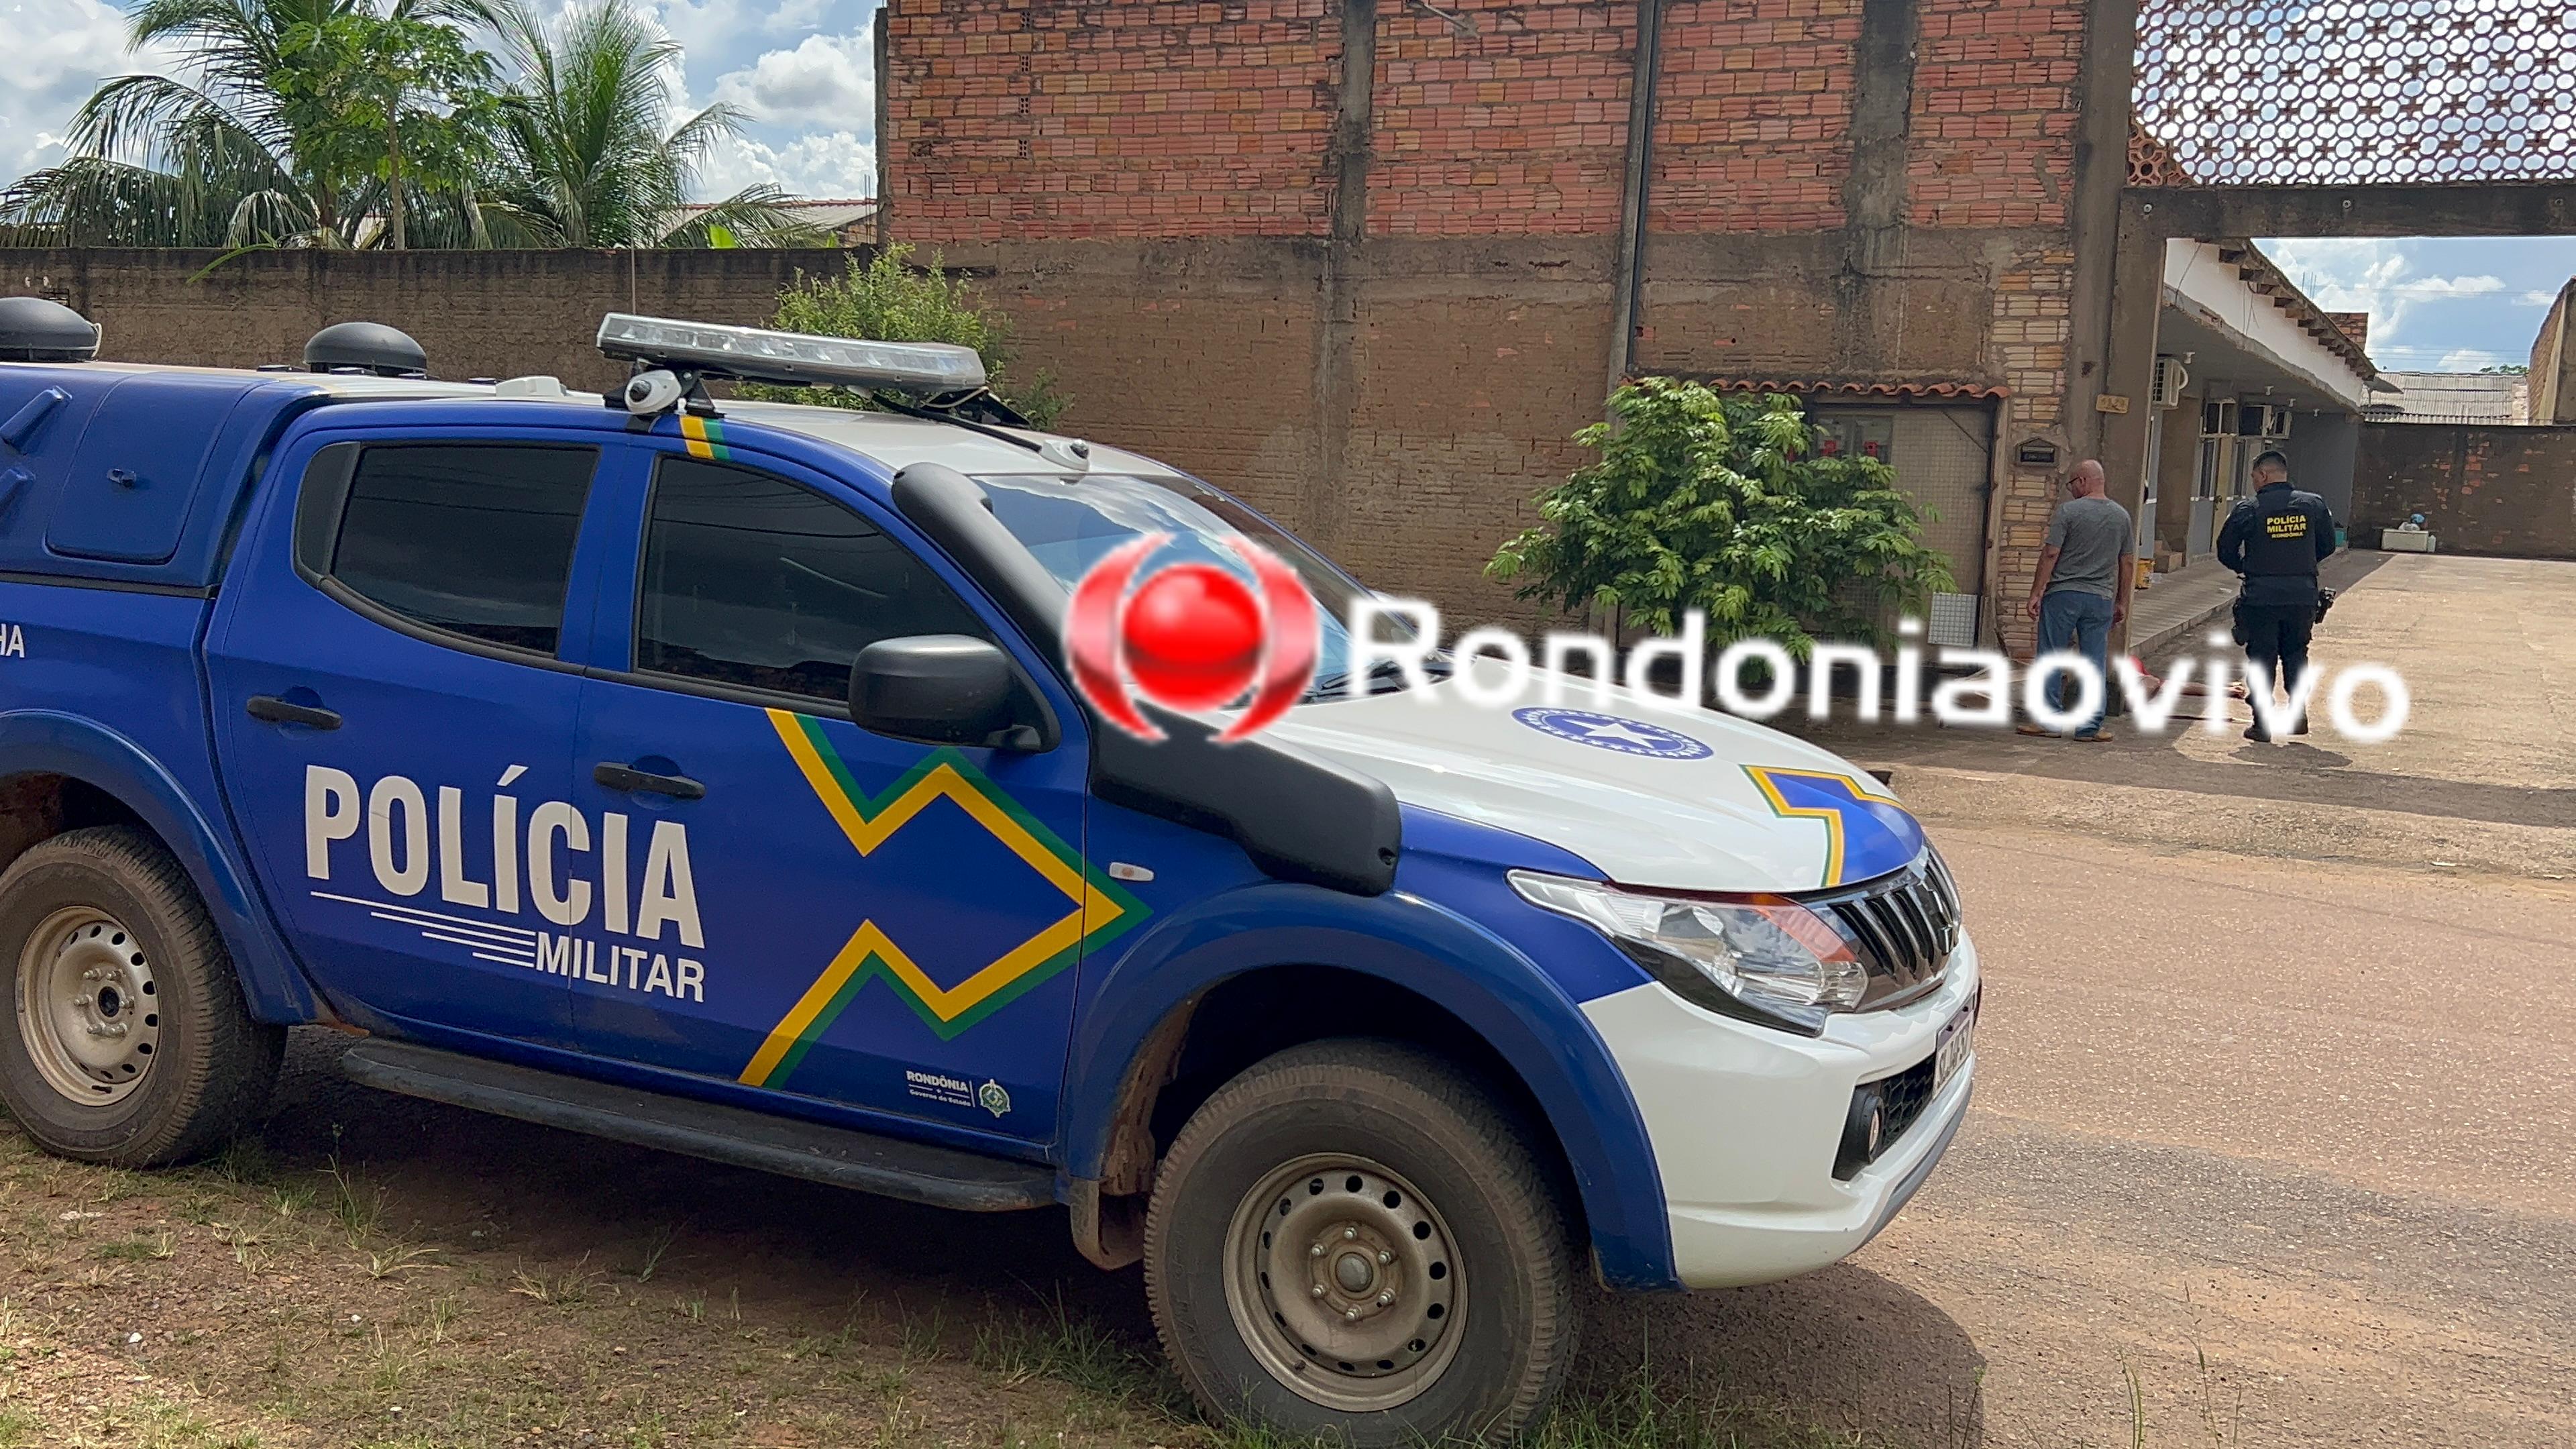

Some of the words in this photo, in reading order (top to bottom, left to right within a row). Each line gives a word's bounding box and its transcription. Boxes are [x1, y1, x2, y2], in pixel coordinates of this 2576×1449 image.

[2267, 515, 2306, 525] POLÍCIA
[2267, 523, 2307, 533] MILITAR
[305, 764, 705, 949] POLÍCIA
[536, 931, 704, 1002] MILITAR
[906, 1070, 969, 1093] RONDÔNIA
